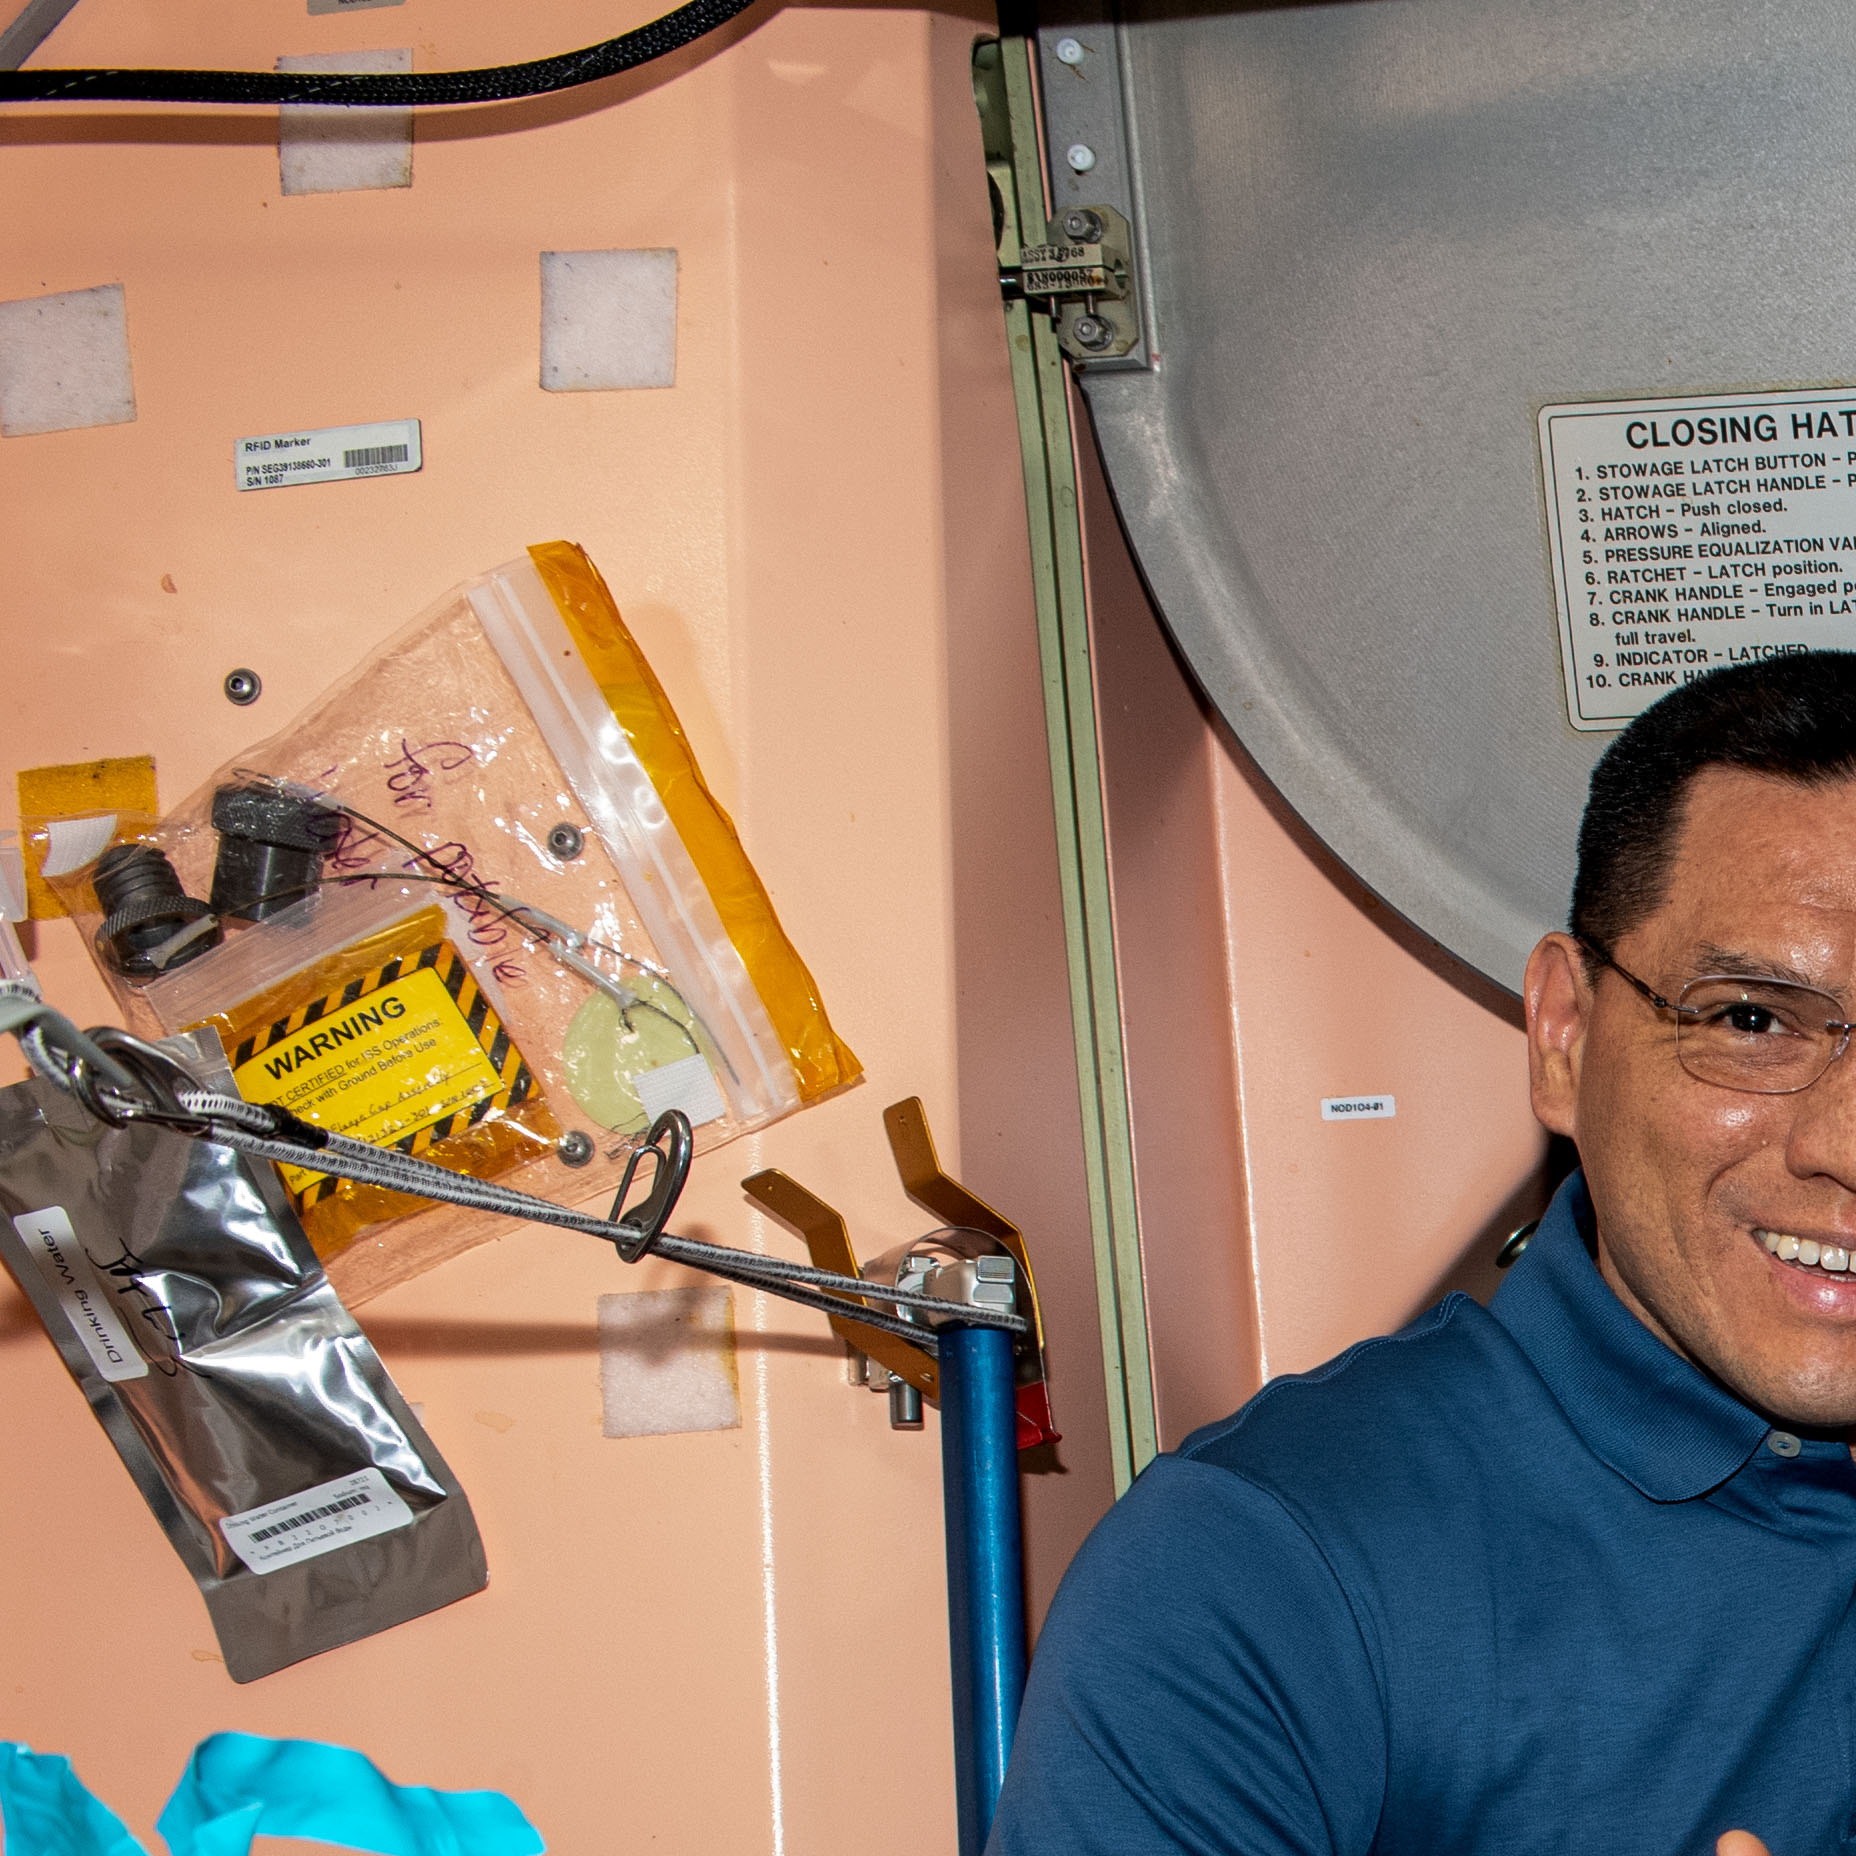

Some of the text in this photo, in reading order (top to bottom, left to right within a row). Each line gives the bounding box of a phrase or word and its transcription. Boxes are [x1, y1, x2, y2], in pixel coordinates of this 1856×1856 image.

[1625, 414, 1777, 449] CLOSING
[245, 438, 311, 452] RFID Marker
[1575, 466, 1590, 481] 1.
[1597, 460, 1684, 479] STOWAGE
[1690, 457, 1749, 475] LATCH
[1756, 453, 1826, 472] BUTTON
[1576, 488, 1592, 502] 2.
[1599, 481, 1686, 501] STOWAGE
[1692, 478, 1751, 497] LATCH
[1757, 475, 1826, 493] HANDLE
[1579, 499, 1787, 523] 3. HATCH Push closed.
[1581, 520, 1766, 543] 4. ARROWS Aligned.
[1583, 550, 1598, 564] 5.
[1605, 545, 1695, 563] PRESSURE
[1698, 537, 1825, 559] EQUALIZATION
[1585, 559, 1843, 585] 6. RATCHET LATCH position.
[1587, 592, 1603, 606] 7.
[1610, 587, 1669, 605] CRANK
[1675, 583, 1743, 601] HANDLE
[1764, 580, 1837, 598] Engaged
[1589, 612, 1605, 626] 8.
[1612, 608, 1671, 625] CRANK
[1677, 604, 1745, 622] HANDLE
[1766, 602, 1803, 618] Turn
[1809, 601, 1824, 615] in
[1615, 629, 1696, 646] full travel.
[1593, 653, 1610, 668] 9.
[1616, 648, 1708, 666] INDICATOR
[1586, 673, 1612, 689] 10.
[1618, 670, 1677, 687] CRANK
[262, 992, 408, 1082] WARNING
[284, 1013, 444, 1103] CERTIFIED for ISS Operations:
[313, 1084, 338, 1104] with
[336, 1063, 379, 1093] Ground
[376, 1046, 414, 1073] Before
[412, 1035, 437, 1055] Use
[38, 1227, 123, 1364] Drinking Water
